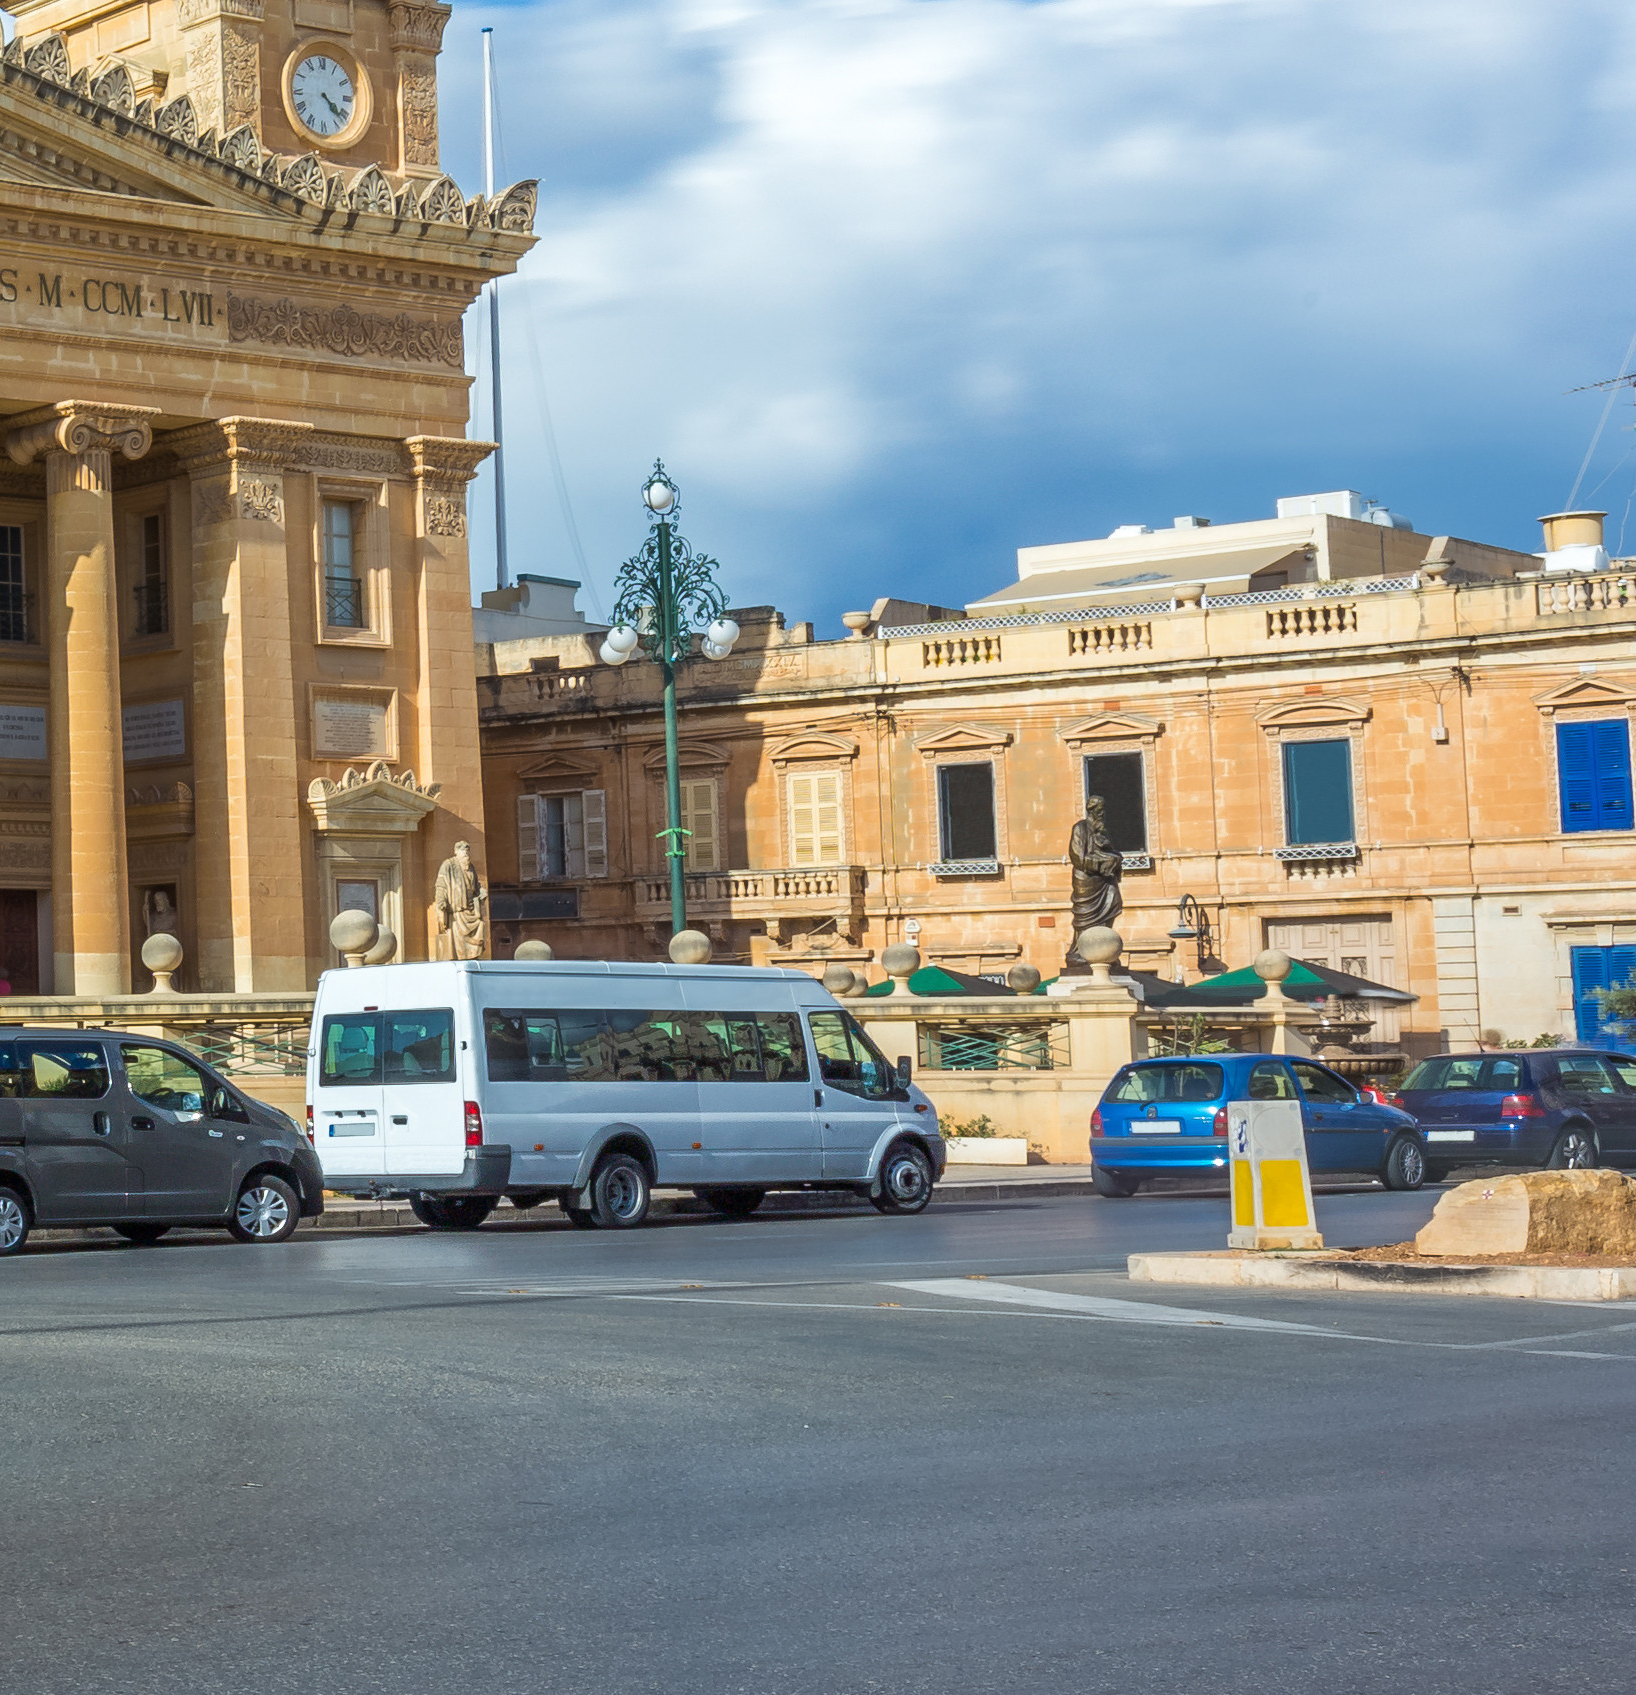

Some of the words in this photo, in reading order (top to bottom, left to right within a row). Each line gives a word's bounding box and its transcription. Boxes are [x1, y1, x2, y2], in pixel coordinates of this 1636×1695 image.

[0, 269, 18, 302] S
[39, 273, 62, 308] M
[83, 278, 143, 318] CCM
